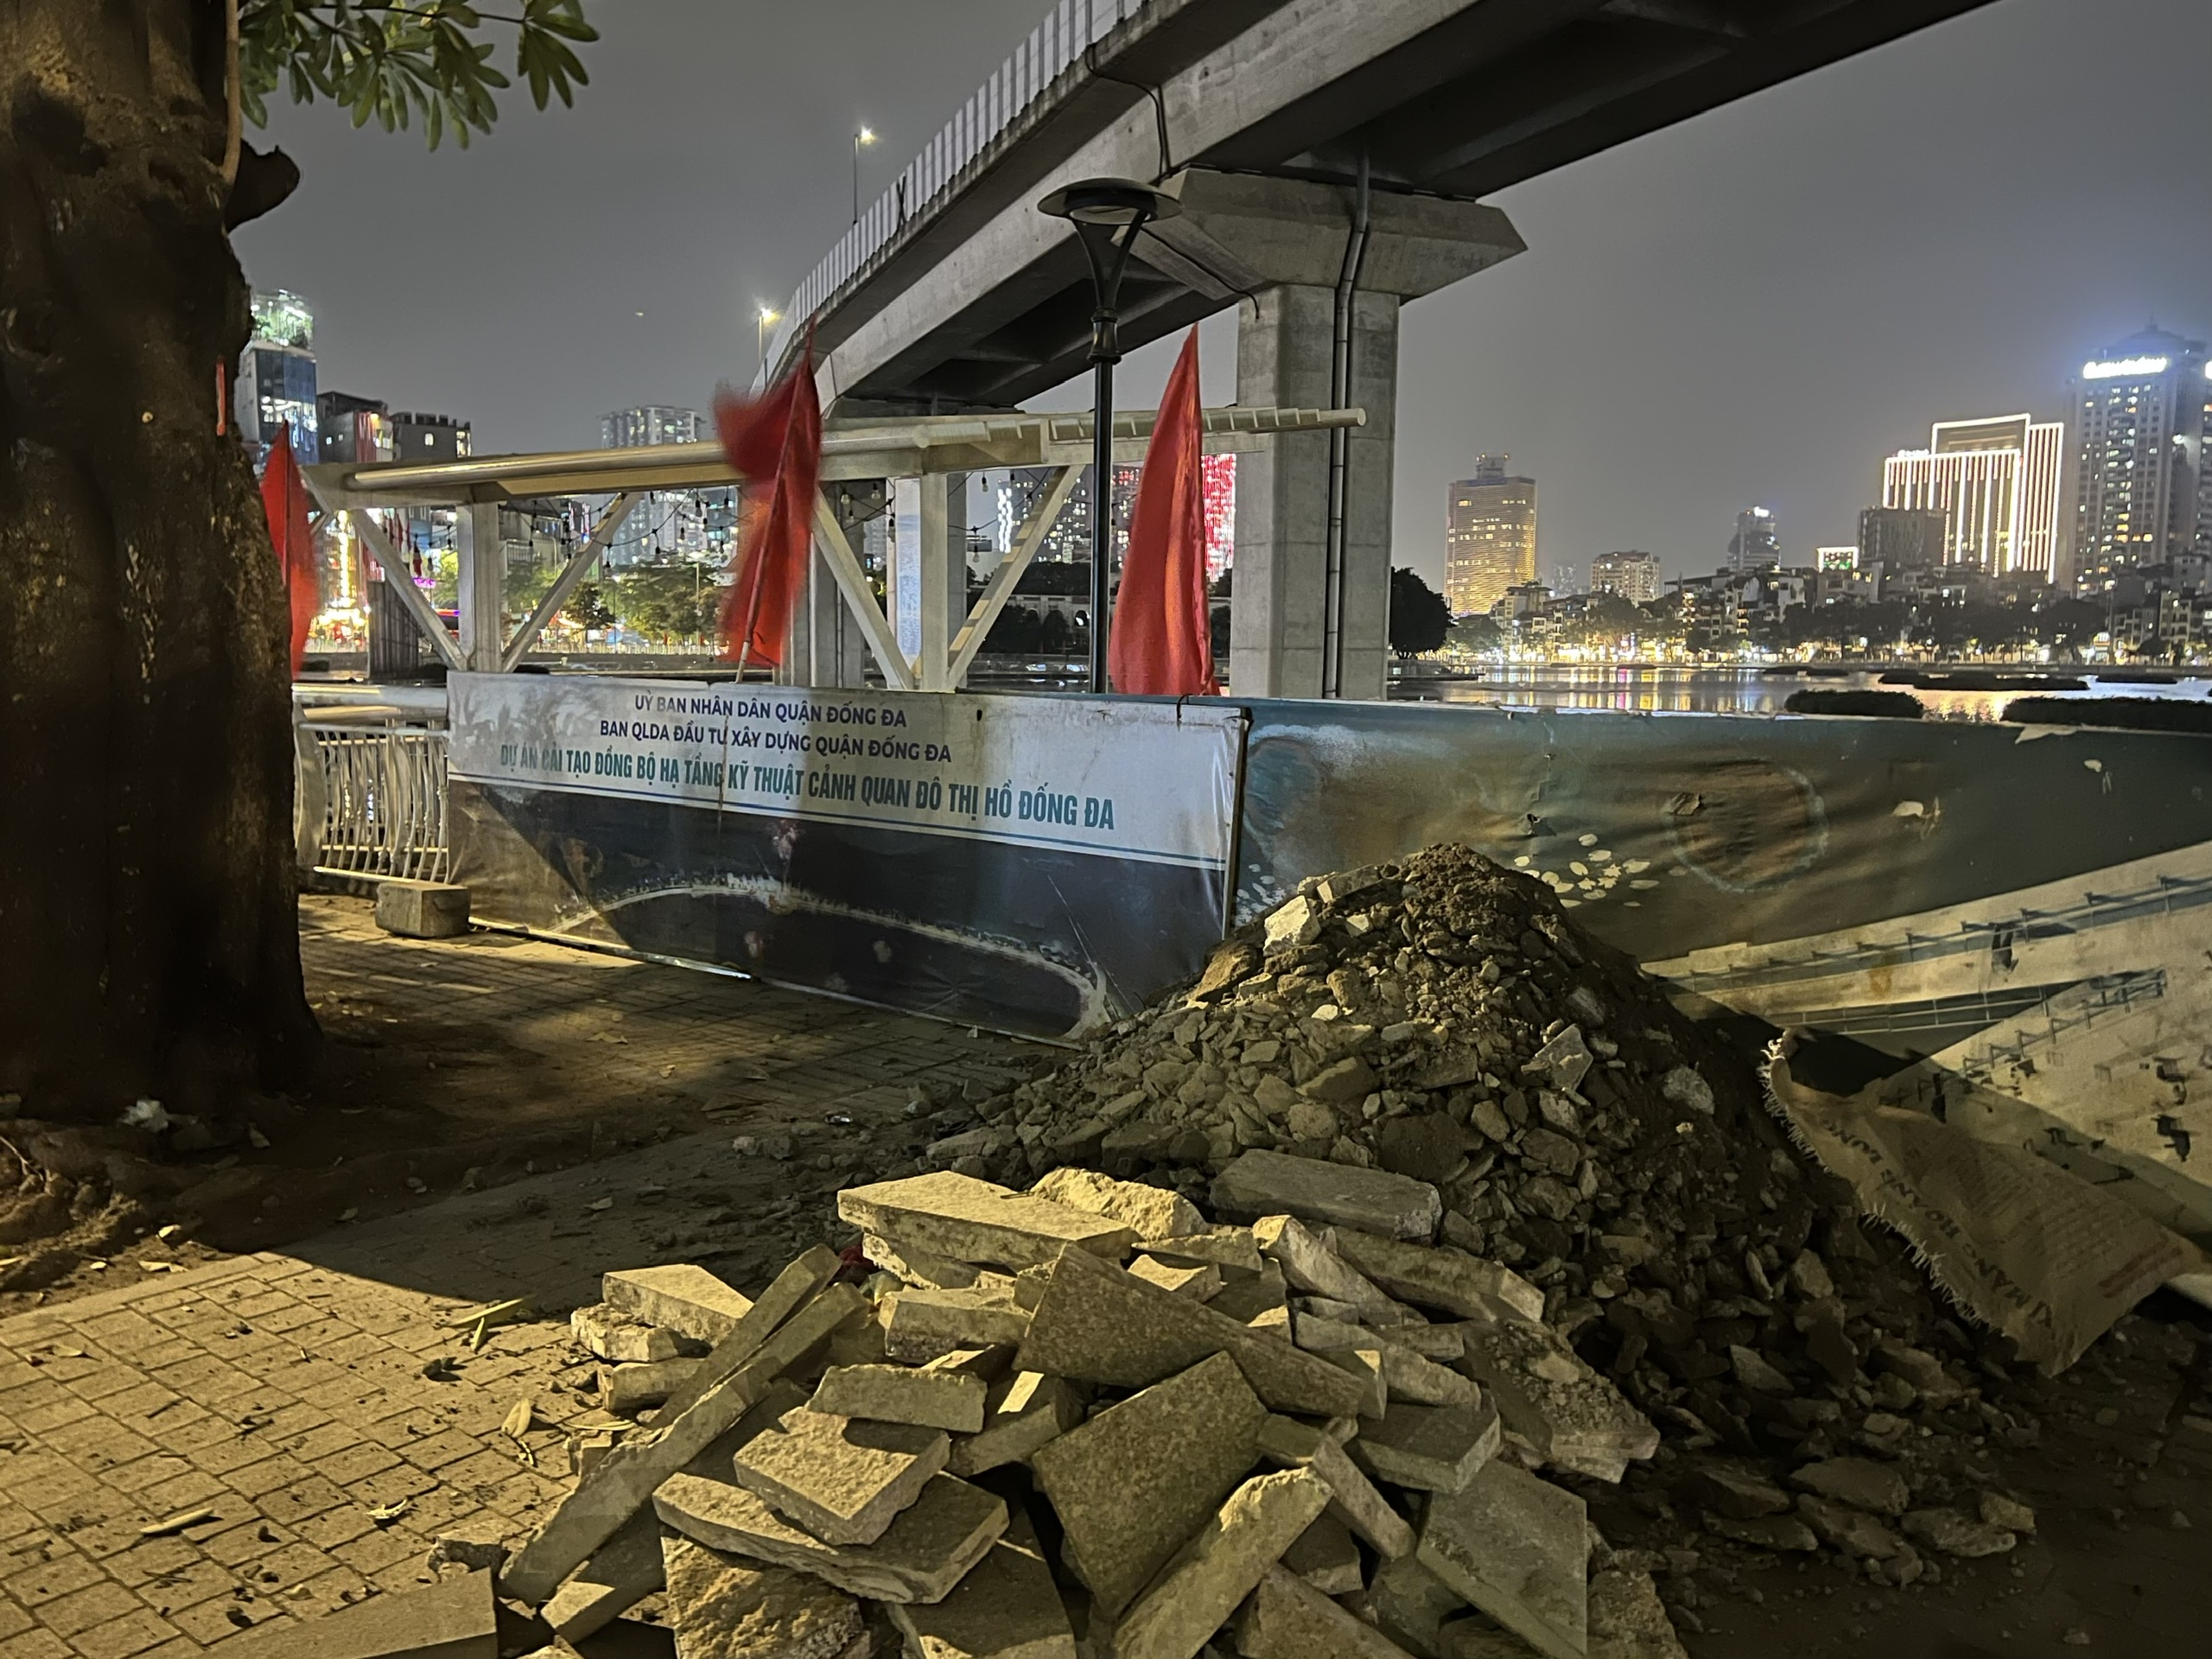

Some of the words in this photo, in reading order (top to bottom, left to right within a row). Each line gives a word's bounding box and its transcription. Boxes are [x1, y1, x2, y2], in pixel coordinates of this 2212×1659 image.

[657, 696, 687, 714] BAN
[691, 695, 733, 716] NHÂN
[737, 697, 771, 719] DÂN
[775, 700, 822, 726] QUẬN
[826, 701, 876, 725] ĐỐNG
[880, 709, 907, 728] ĐA
[600, 720, 628, 738] BAN
[632, 721, 670, 741] QLDA
[673, 720, 704, 743] ĐẦU
[731, 726, 762, 748] XÂY
[765, 730, 811, 754] DỰNG
[815, 734, 864, 760] QUẬN
[868, 734, 920, 760] ĐỐNG
[925, 744, 952, 763] ĐA
[500, 743, 518, 772] DỰ
[541, 741, 563, 772] CẢI
[566, 749, 591, 779] TẠO
[636, 751, 656, 785] BỘ
[659, 758, 680, 789] HẠ
[683, 752, 724, 788] TẦNG
[728, 760, 749, 791] KỸ
[753, 763, 804, 800] THUẬT
[808, 764, 856, 802] CẢNH
[861, 775, 911, 808] QUAN
[915, 776, 942, 810] ĐÔ
[948, 783, 979, 821] THỊ
[984, 779, 1013, 818] HỒ
[1018, 782, 1077, 826] ĐỐNG
[1084, 797, 1115, 830] ĐA
